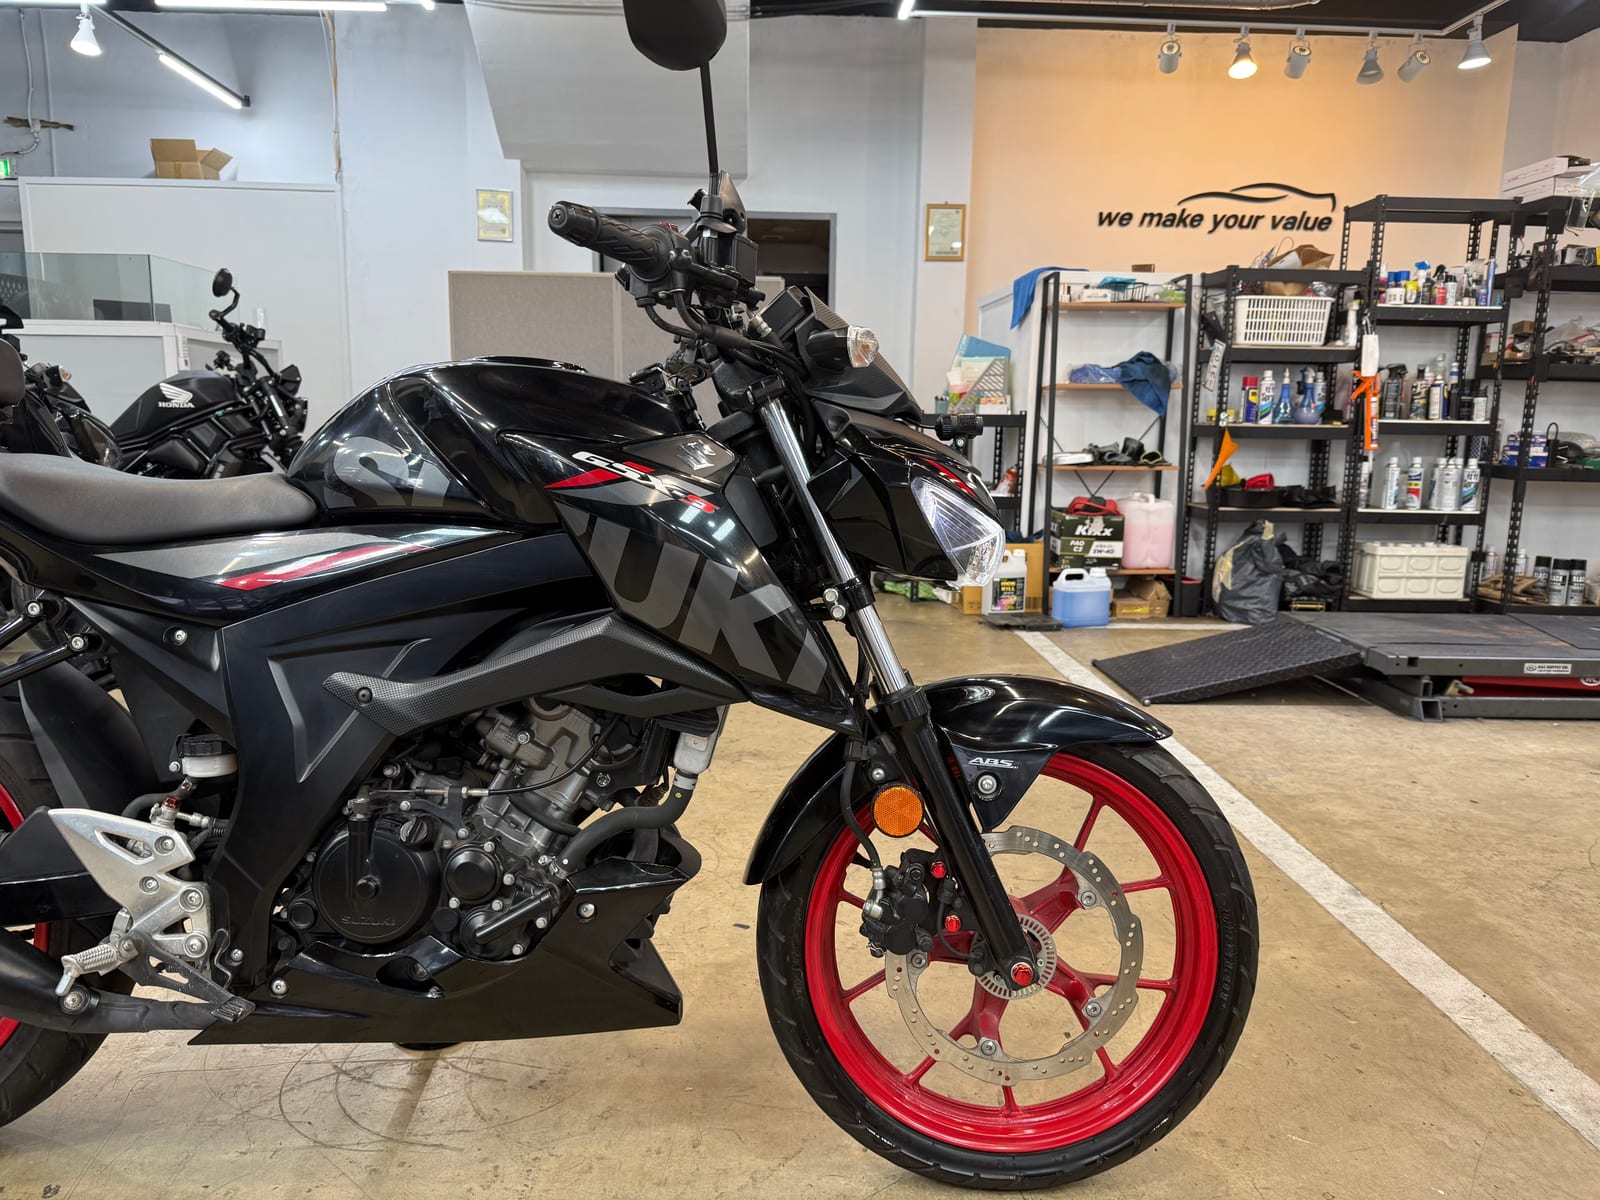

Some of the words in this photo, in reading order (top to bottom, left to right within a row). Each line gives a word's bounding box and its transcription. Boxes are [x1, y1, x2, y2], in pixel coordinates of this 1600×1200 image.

[1098, 210, 1133, 227] we
[1138, 208, 1204, 228] make
[1207, 213, 1265, 234] your
[1270, 211, 1333, 231] value
[968, 757, 1017, 769] ABS
